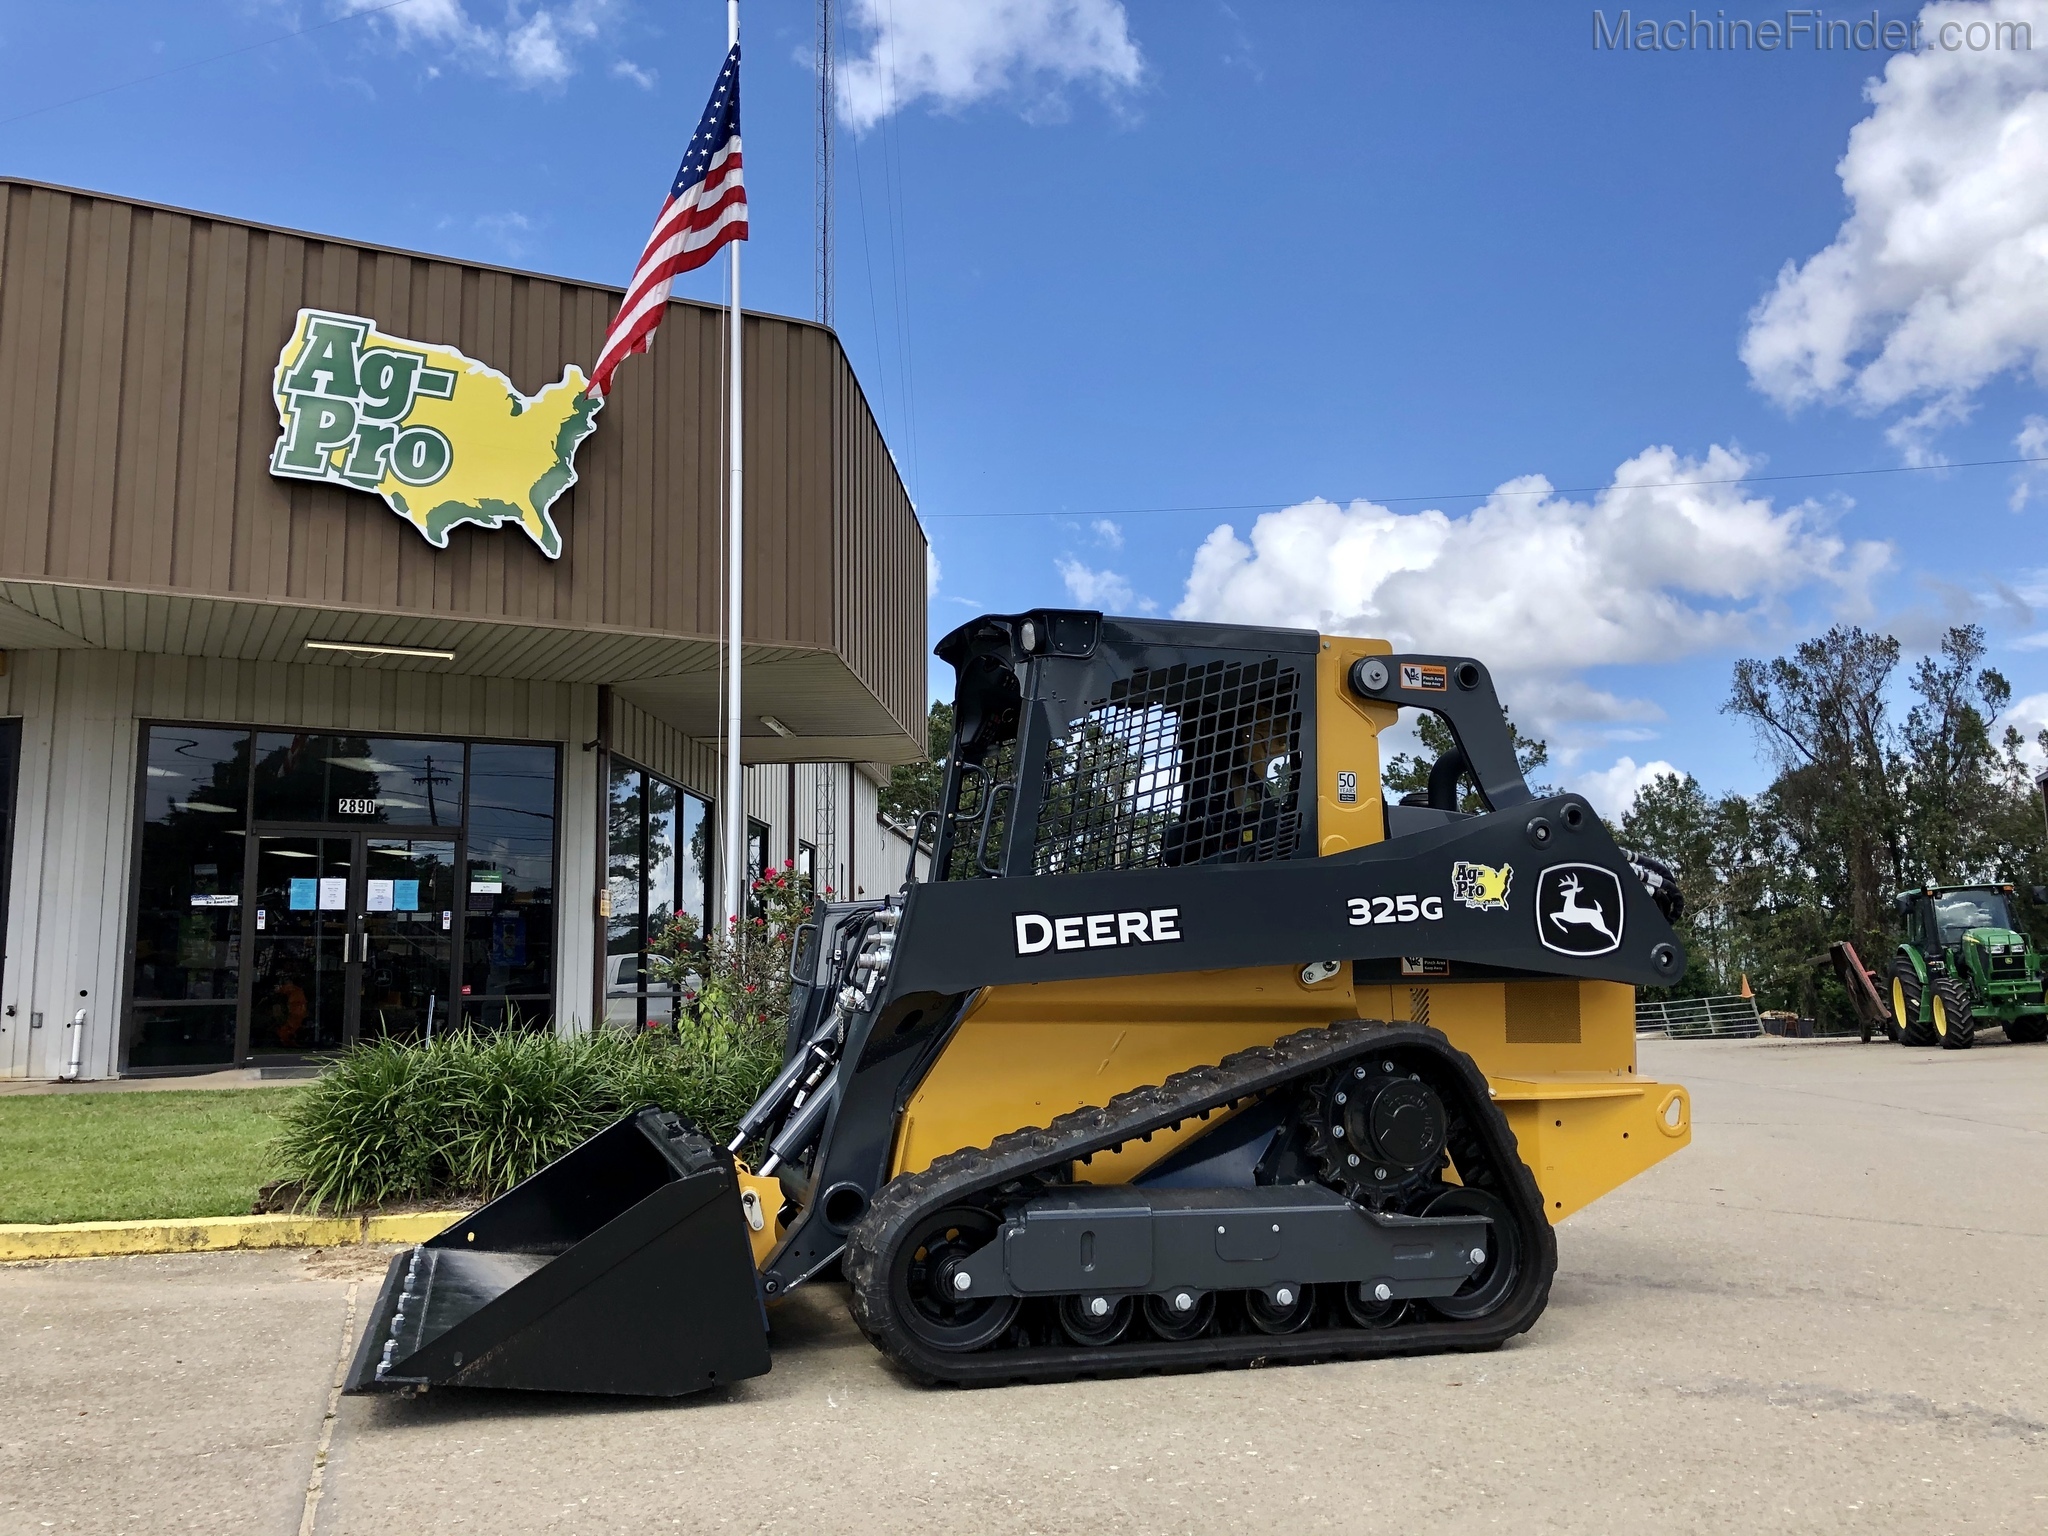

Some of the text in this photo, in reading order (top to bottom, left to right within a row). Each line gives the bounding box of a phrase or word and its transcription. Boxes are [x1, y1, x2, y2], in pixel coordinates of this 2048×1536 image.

[280, 314, 457, 422] Ag-
[276, 393, 453, 484] Pro
[1339, 773, 1355, 787] 50
[340, 799, 374, 814] 2890
[1455, 864, 1484, 884] Ag-
[1456, 881, 1485, 898] Pro
[1347, 894, 1443, 926] 325G
[1015, 908, 1181, 954] DEERE
